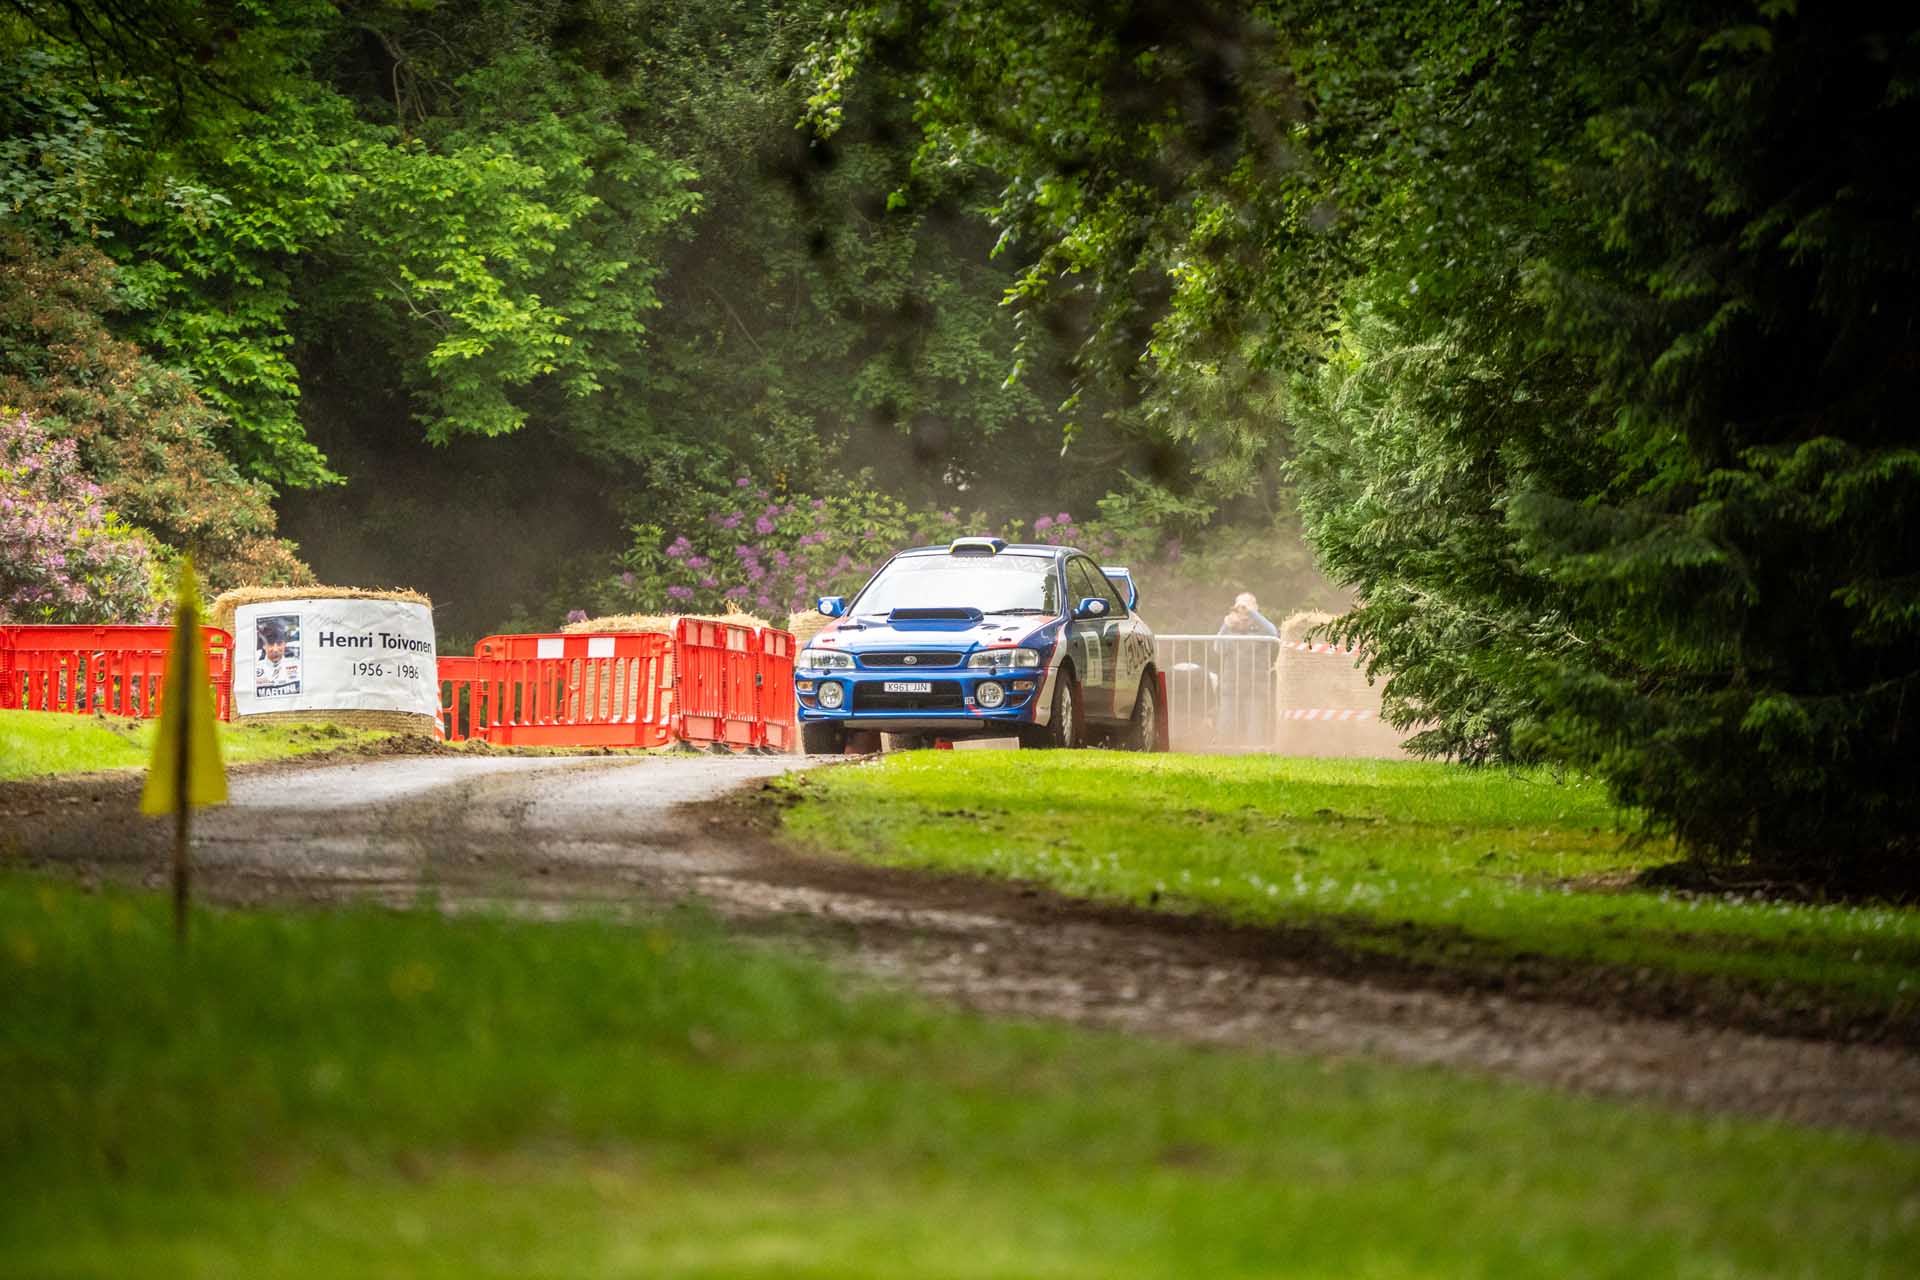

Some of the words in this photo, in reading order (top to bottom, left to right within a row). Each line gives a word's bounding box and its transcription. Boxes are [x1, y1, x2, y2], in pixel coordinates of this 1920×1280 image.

[319, 631, 373, 648] Henri
[378, 632, 432, 654] Toivonen
[352, 663, 383, 677] 1956
[397, 665, 419, 679] 1986
